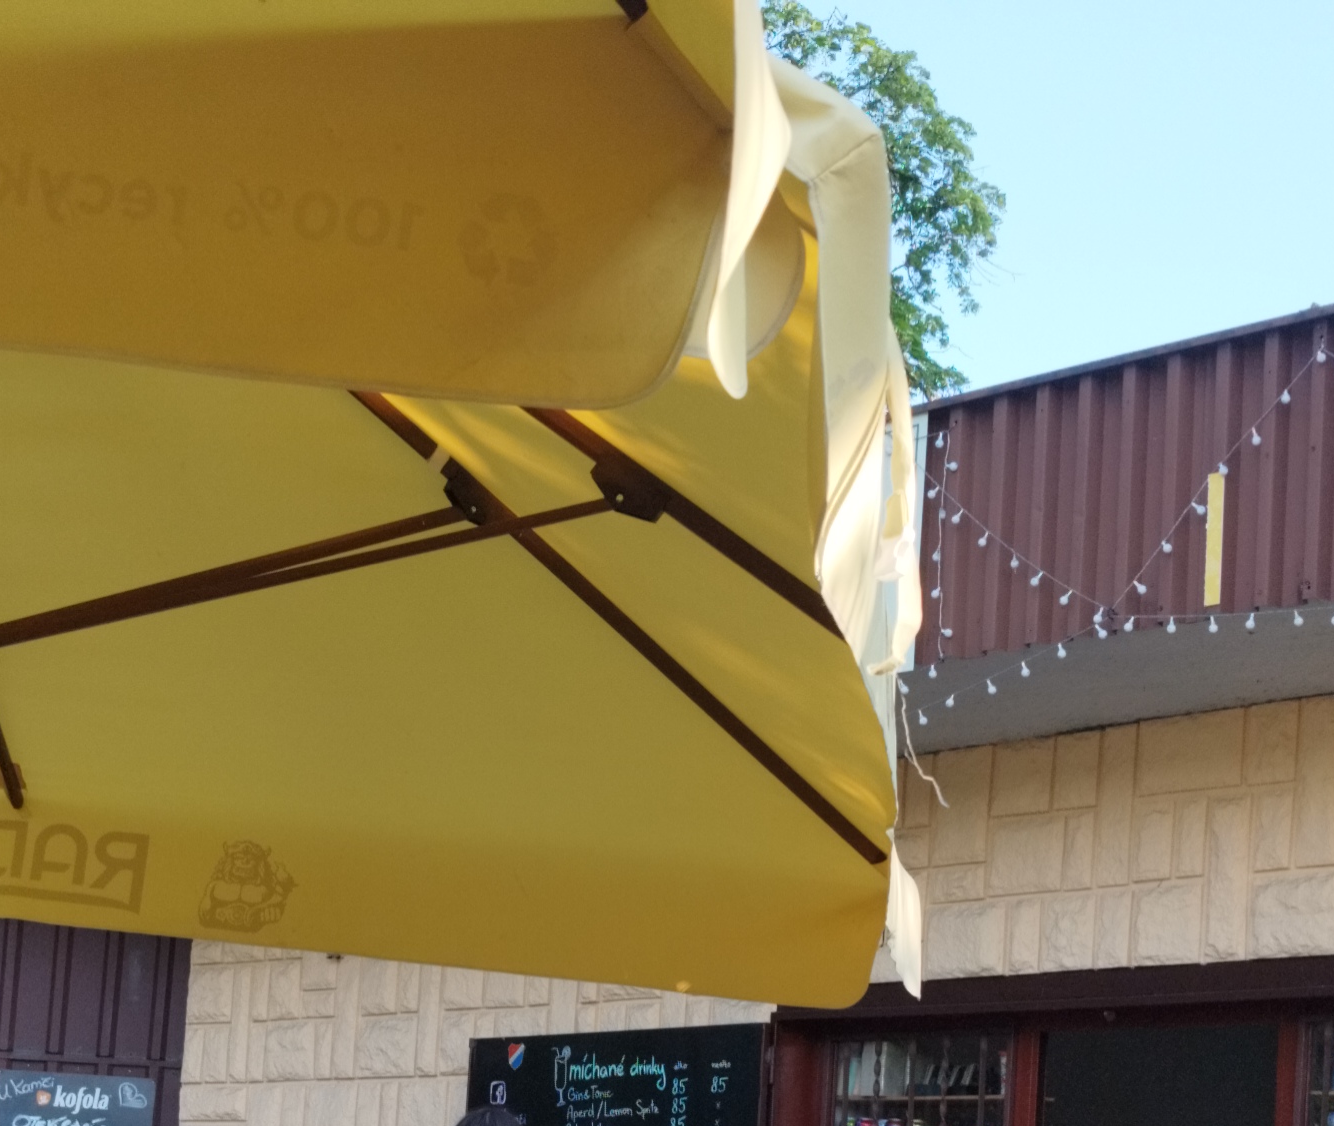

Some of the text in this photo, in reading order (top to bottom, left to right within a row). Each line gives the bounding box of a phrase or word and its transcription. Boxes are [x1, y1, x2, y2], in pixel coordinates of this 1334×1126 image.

[569, 1053, 625, 1081] míchané
[630, 1054, 667, 1091] drinky
[672, 1077, 689, 1095] 85
[711, 1076, 729, 1093] 85
[53, 1085, 109, 1114] kofola
[672, 1097, 688, 1114] 85
